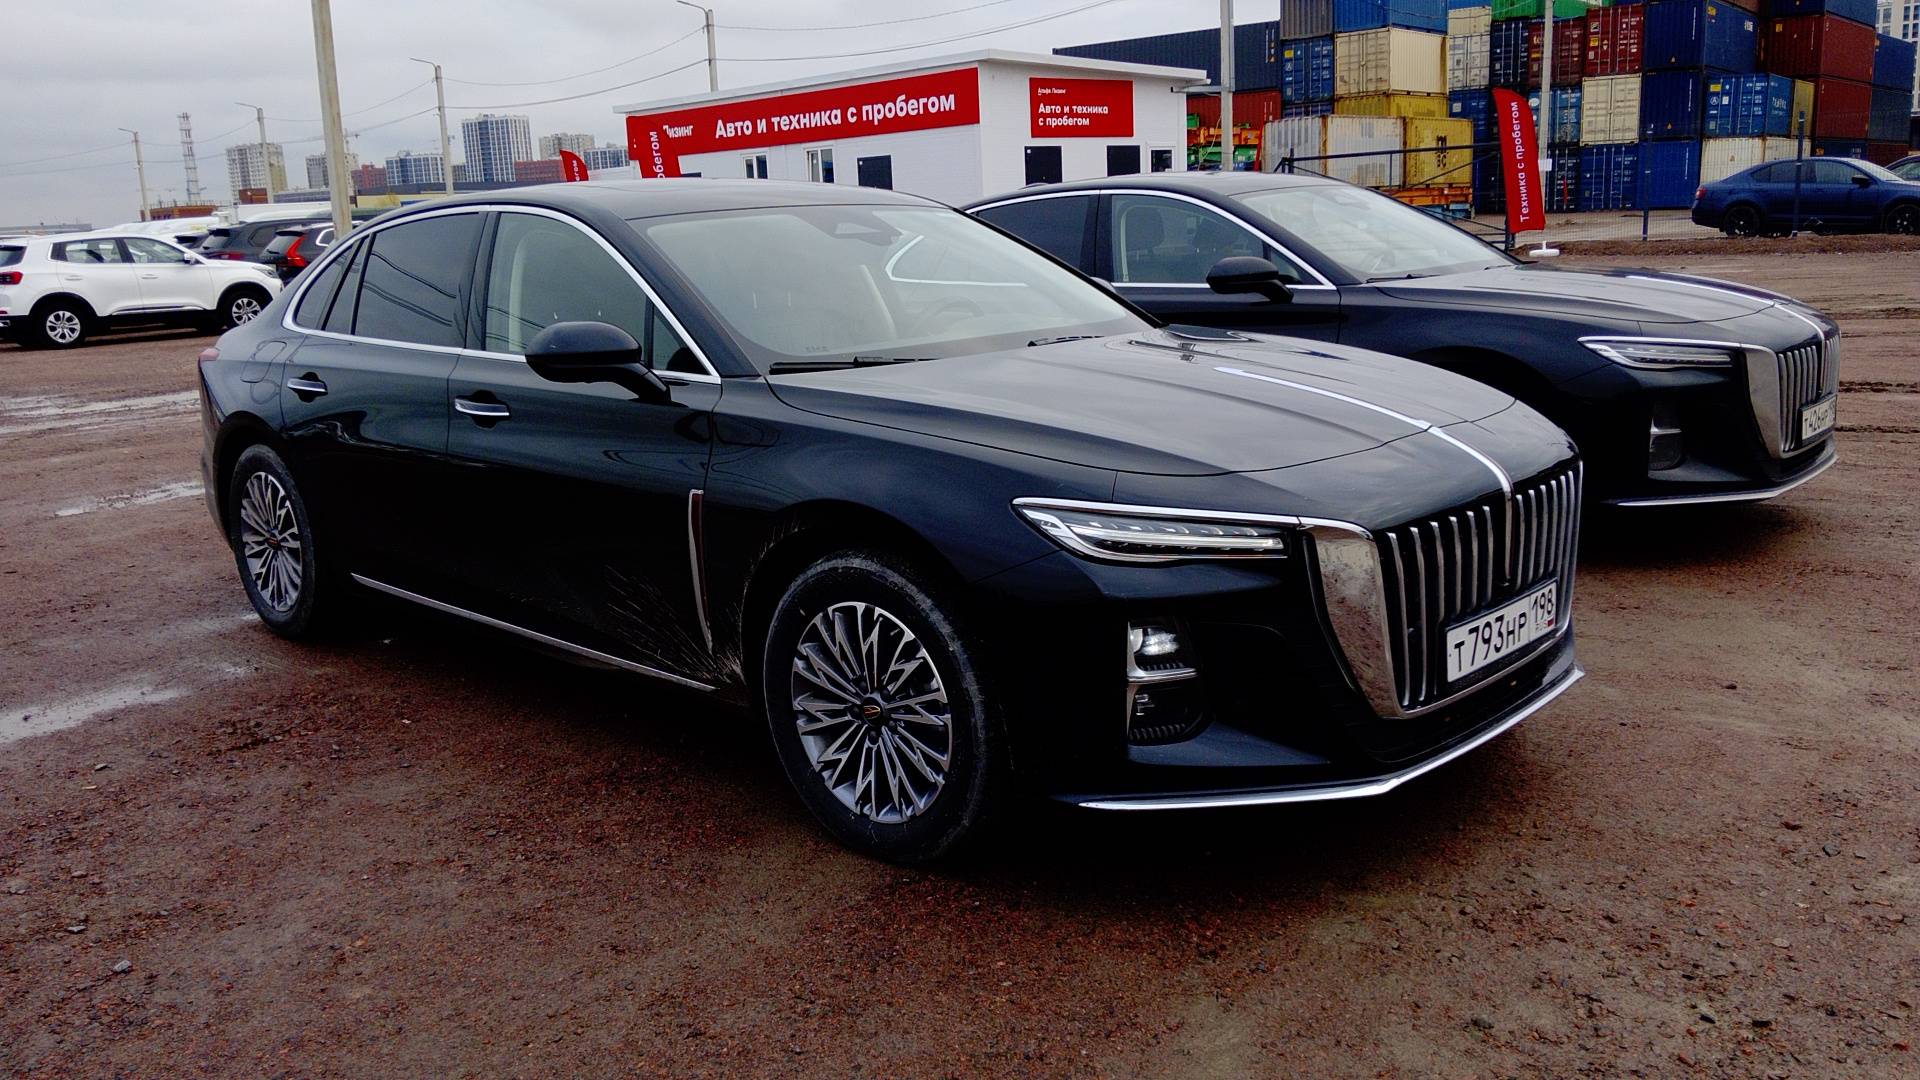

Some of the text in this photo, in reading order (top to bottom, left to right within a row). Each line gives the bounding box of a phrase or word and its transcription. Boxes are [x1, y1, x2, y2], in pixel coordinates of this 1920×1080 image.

[715, 94, 955, 138] Авто и техника с пробегом
[1038, 103, 1108, 114] Авто и техника
[1038, 115, 1090, 128] с пробегом
[1510, 101, 1525, 159] пробегом
[1518, 172, 1530, 223] Техника
[1453, 587, 1554, 673] Т793НР 198
